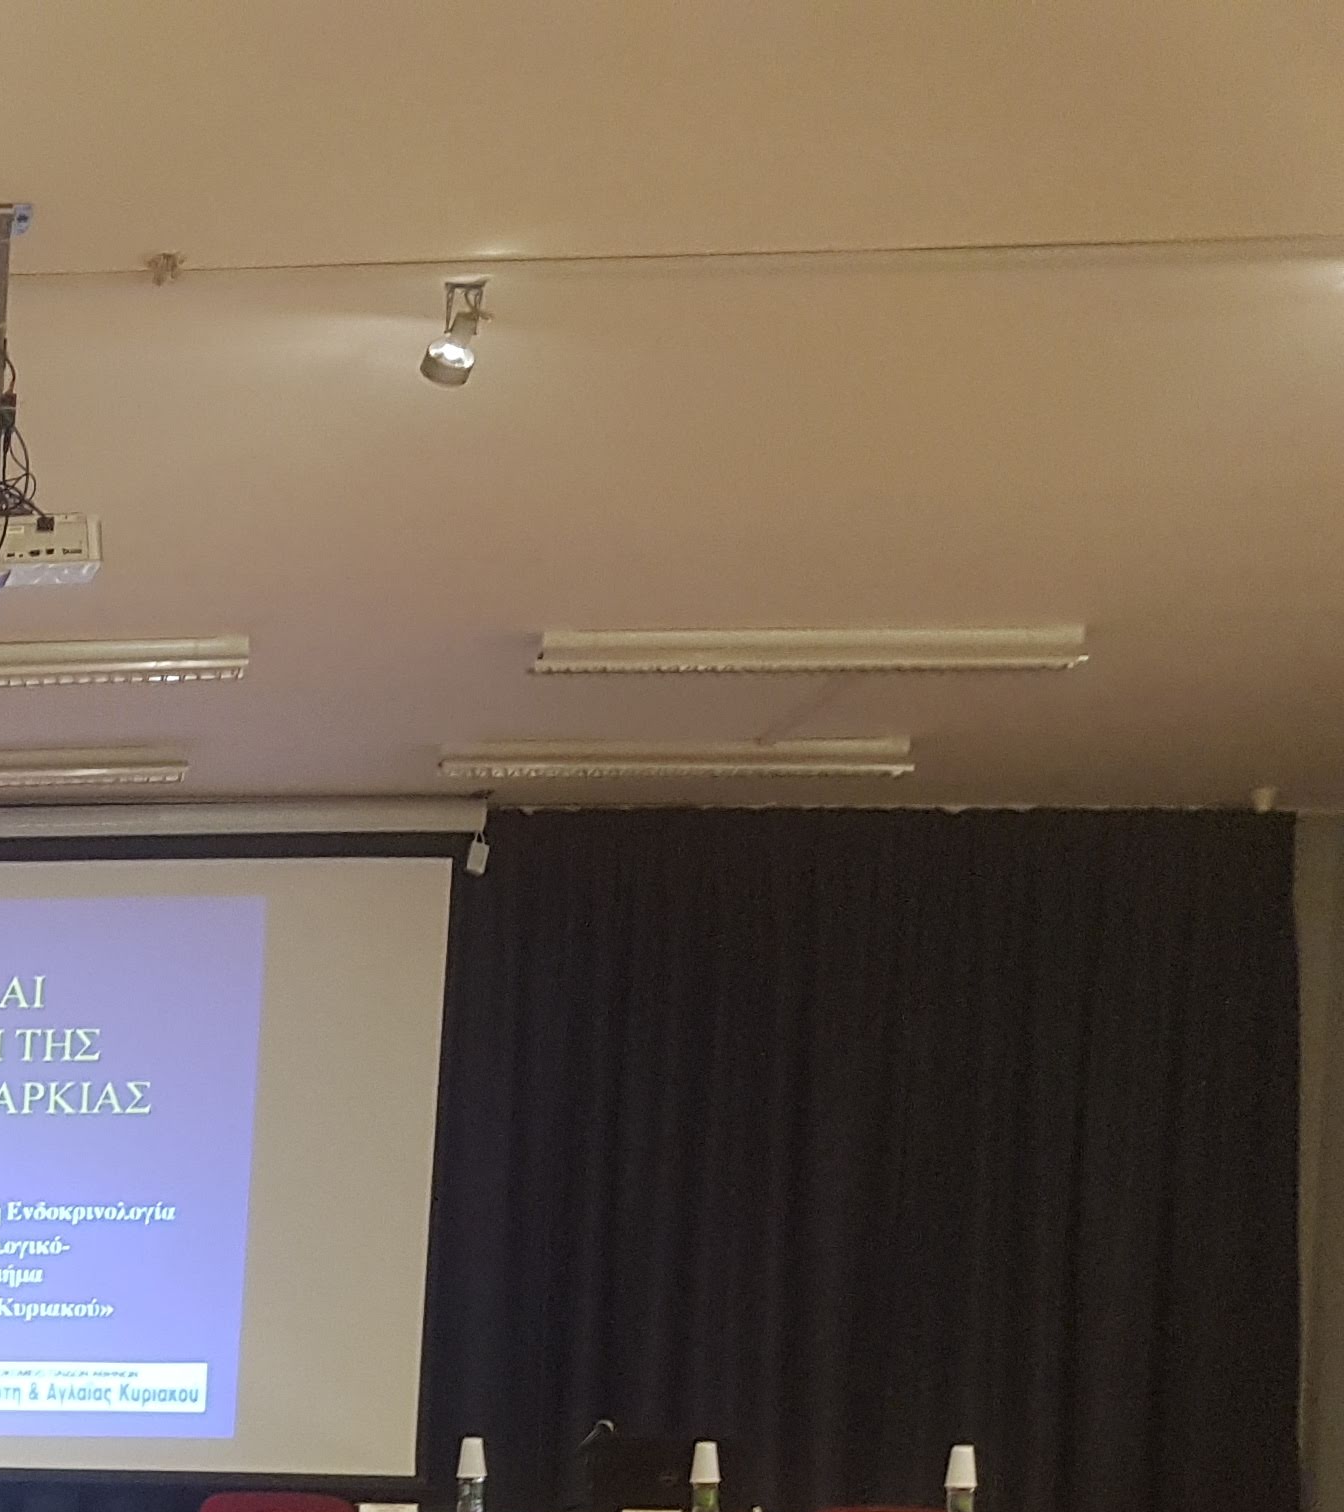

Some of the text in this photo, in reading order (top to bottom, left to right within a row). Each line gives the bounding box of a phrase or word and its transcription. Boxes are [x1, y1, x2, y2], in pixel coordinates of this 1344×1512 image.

[15, 1028, 102, 1062] ΤΗΣ
[6, 1201, 176, 1225] Ενδοκρινολογία
[28, 1382, 39, 1401] &
